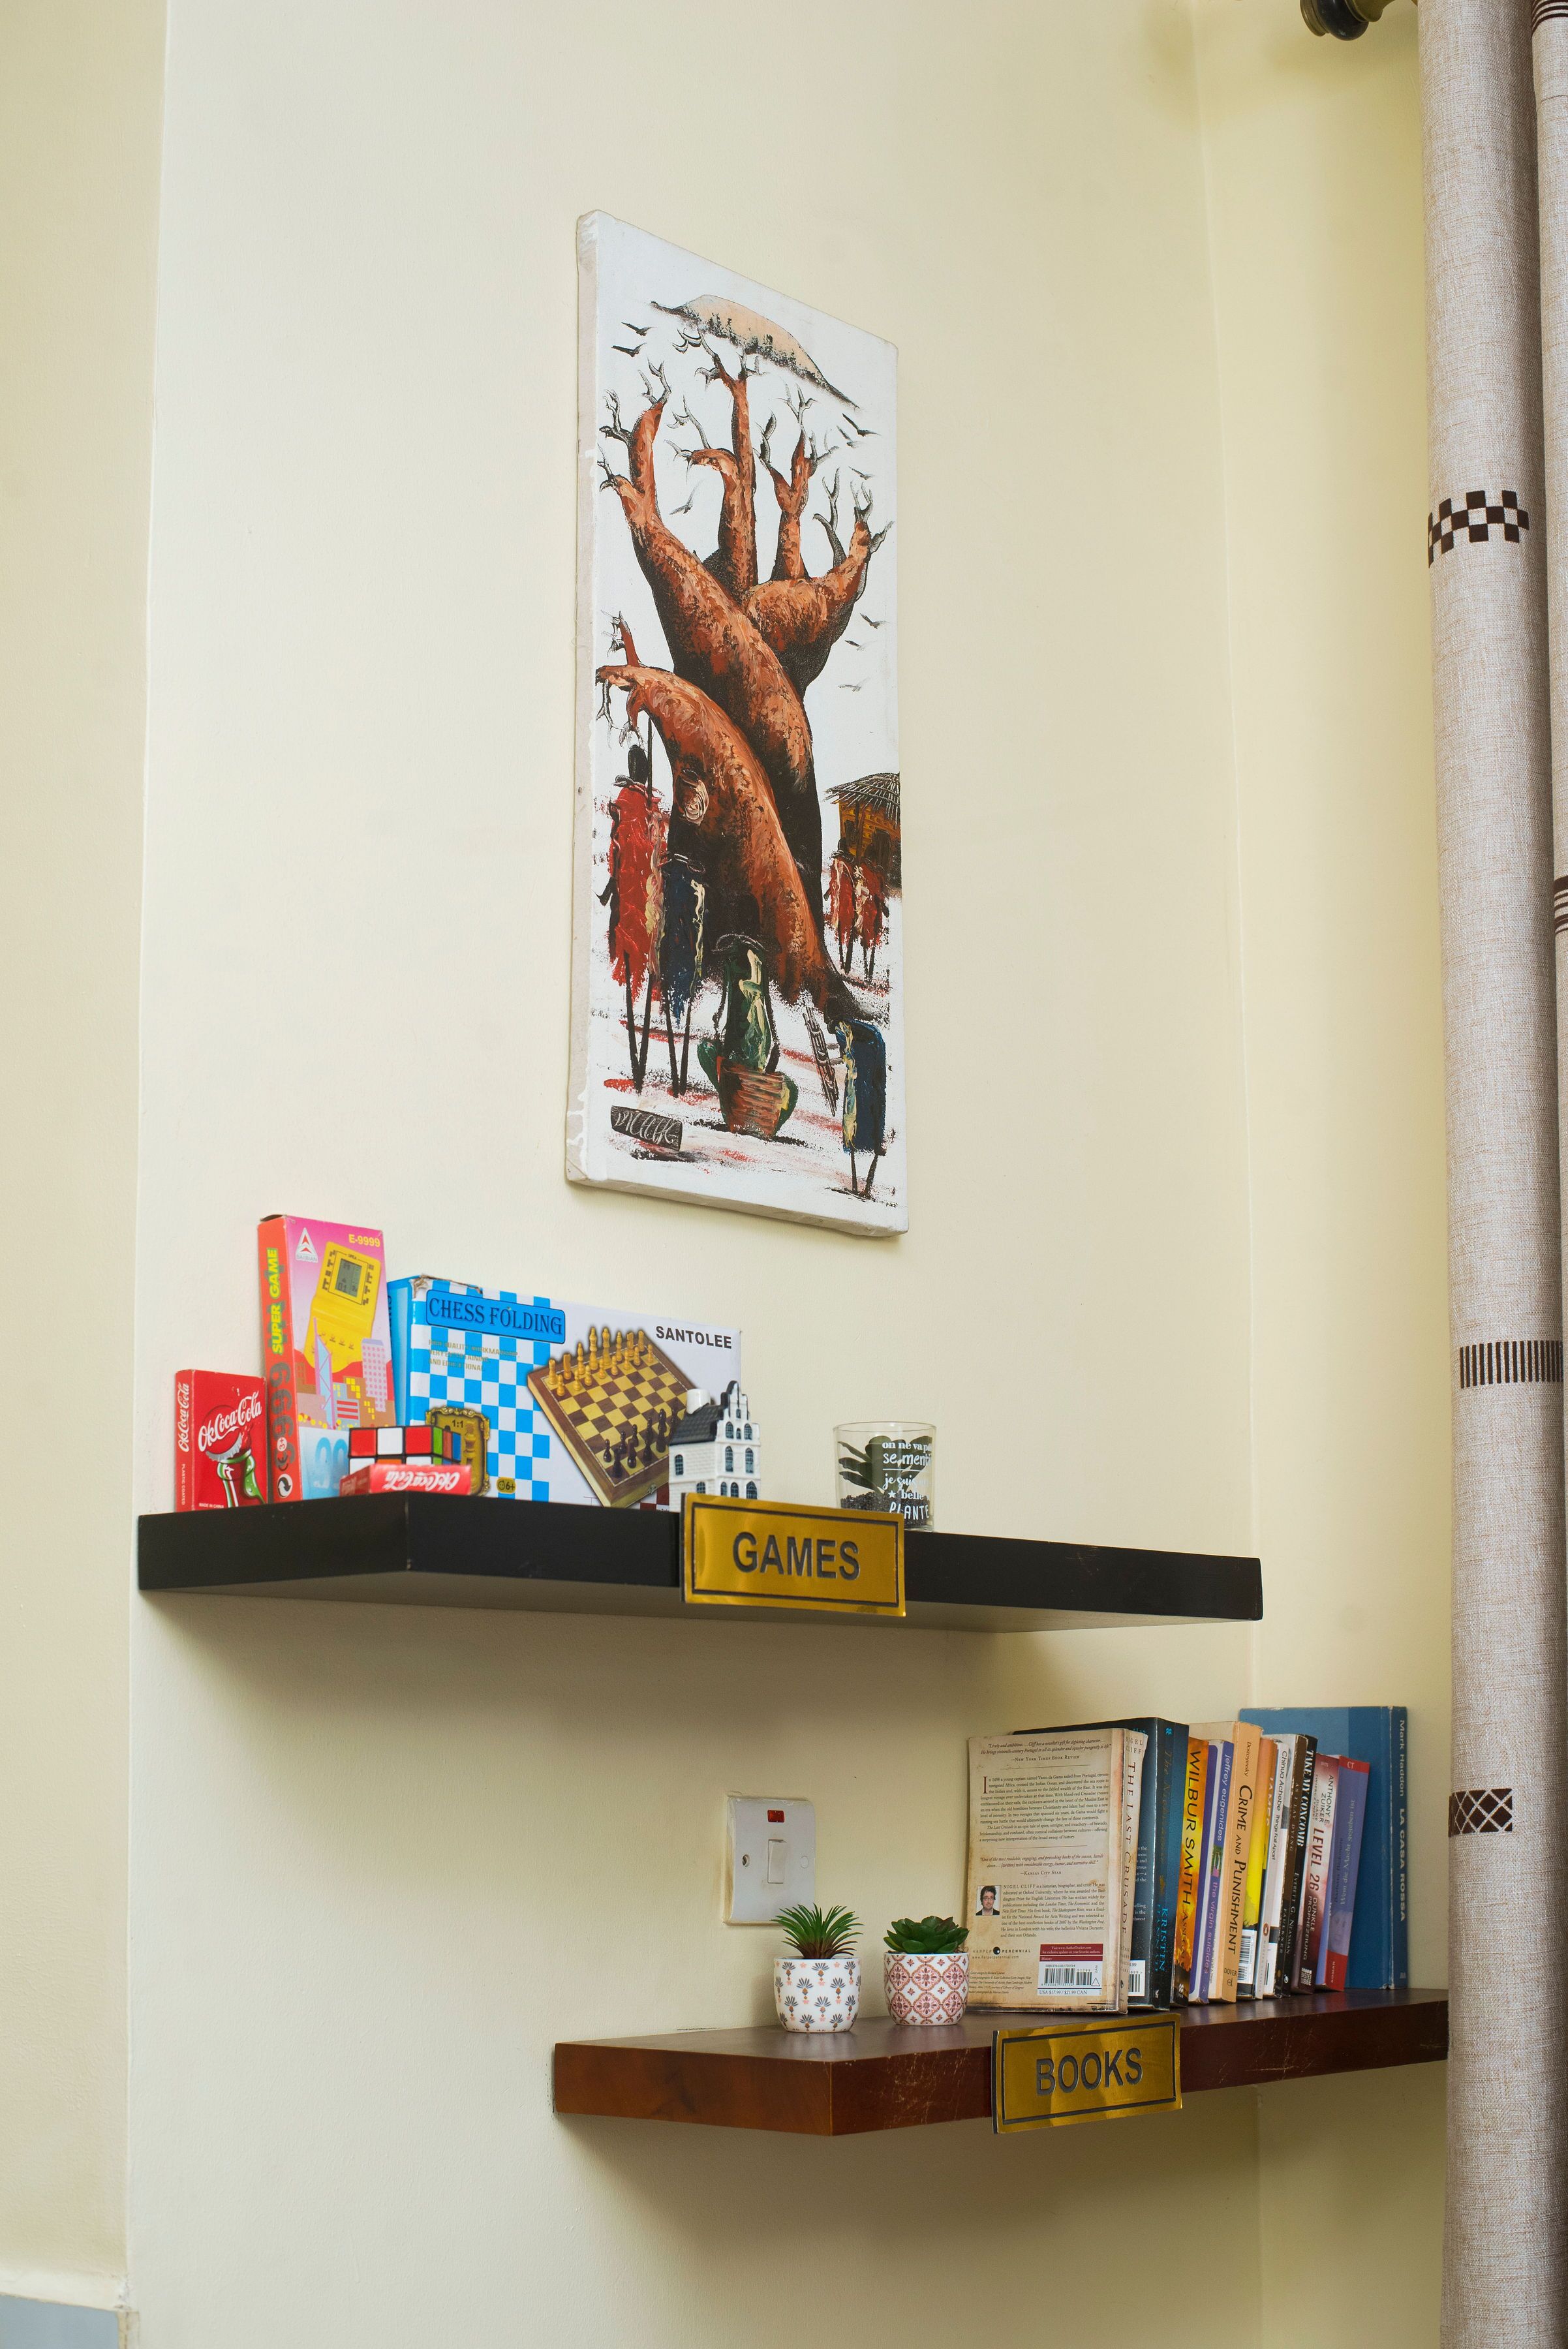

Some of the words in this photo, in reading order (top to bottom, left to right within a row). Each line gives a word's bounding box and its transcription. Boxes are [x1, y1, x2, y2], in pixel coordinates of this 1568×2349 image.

[348, 1234, 380, 1248] E-9999
[267, 1248, 281, 1299] GAME
[271, 1303, 284, 1355] SUPER
[429, 1297, 485, 1323] CHESS
[490, 1306, 562, 1335] FOLDING
[656, 1325, 732, 1349] SANTOLEE
[452, 1419, 464, 1428] 1:1
[883, 1452, 898, 1464] se
[505, 1481, 515, 1490] 6+
[882, 1473, 897, 1490] je
[732, 1531, 861, 1581] GAMES
[1128, 1762, 1136, 1796] THE
[1222, 1754, 1231, 1786] jeffrey
[1304, 1749, 1314, 1777] TAKE
[1347, 1761, 1355, 1770] CT
[1186, 1751, 1201, 1832] WILBUR
[1301, 1778, 1311, 1796] MY
[1325, 1775, 1334, 1817] ANTHONY
[1218, 1789, 1227, 1841] eugenides
[1237, 1785, 1253, 1832] CRIME
[1297, 1796, 1309, 1847] COXCOMB
[1400, 1808, 1406, 1826] LA
[1311, 1827, 1325, 1867] LEVEL
[1182, 1837, 1195, 1905] SMITH
[1309, 1874, 1321, 1891] 26
[1121, 1850, 1131, 1934] CRUSADE
[1228, 1859, 1247, 1954] PUNISHMENT
[1207, 1900, 1217, 1929] virgin
[1302, 1896, 1312, 1961] PROPHEZEIUNG
[1159, 1907, 1169, 1971] KRISTIN
[1223, 1967, 1237, 1977] DOVER
[1036, 2047, 1143, 2096] BOOKS
